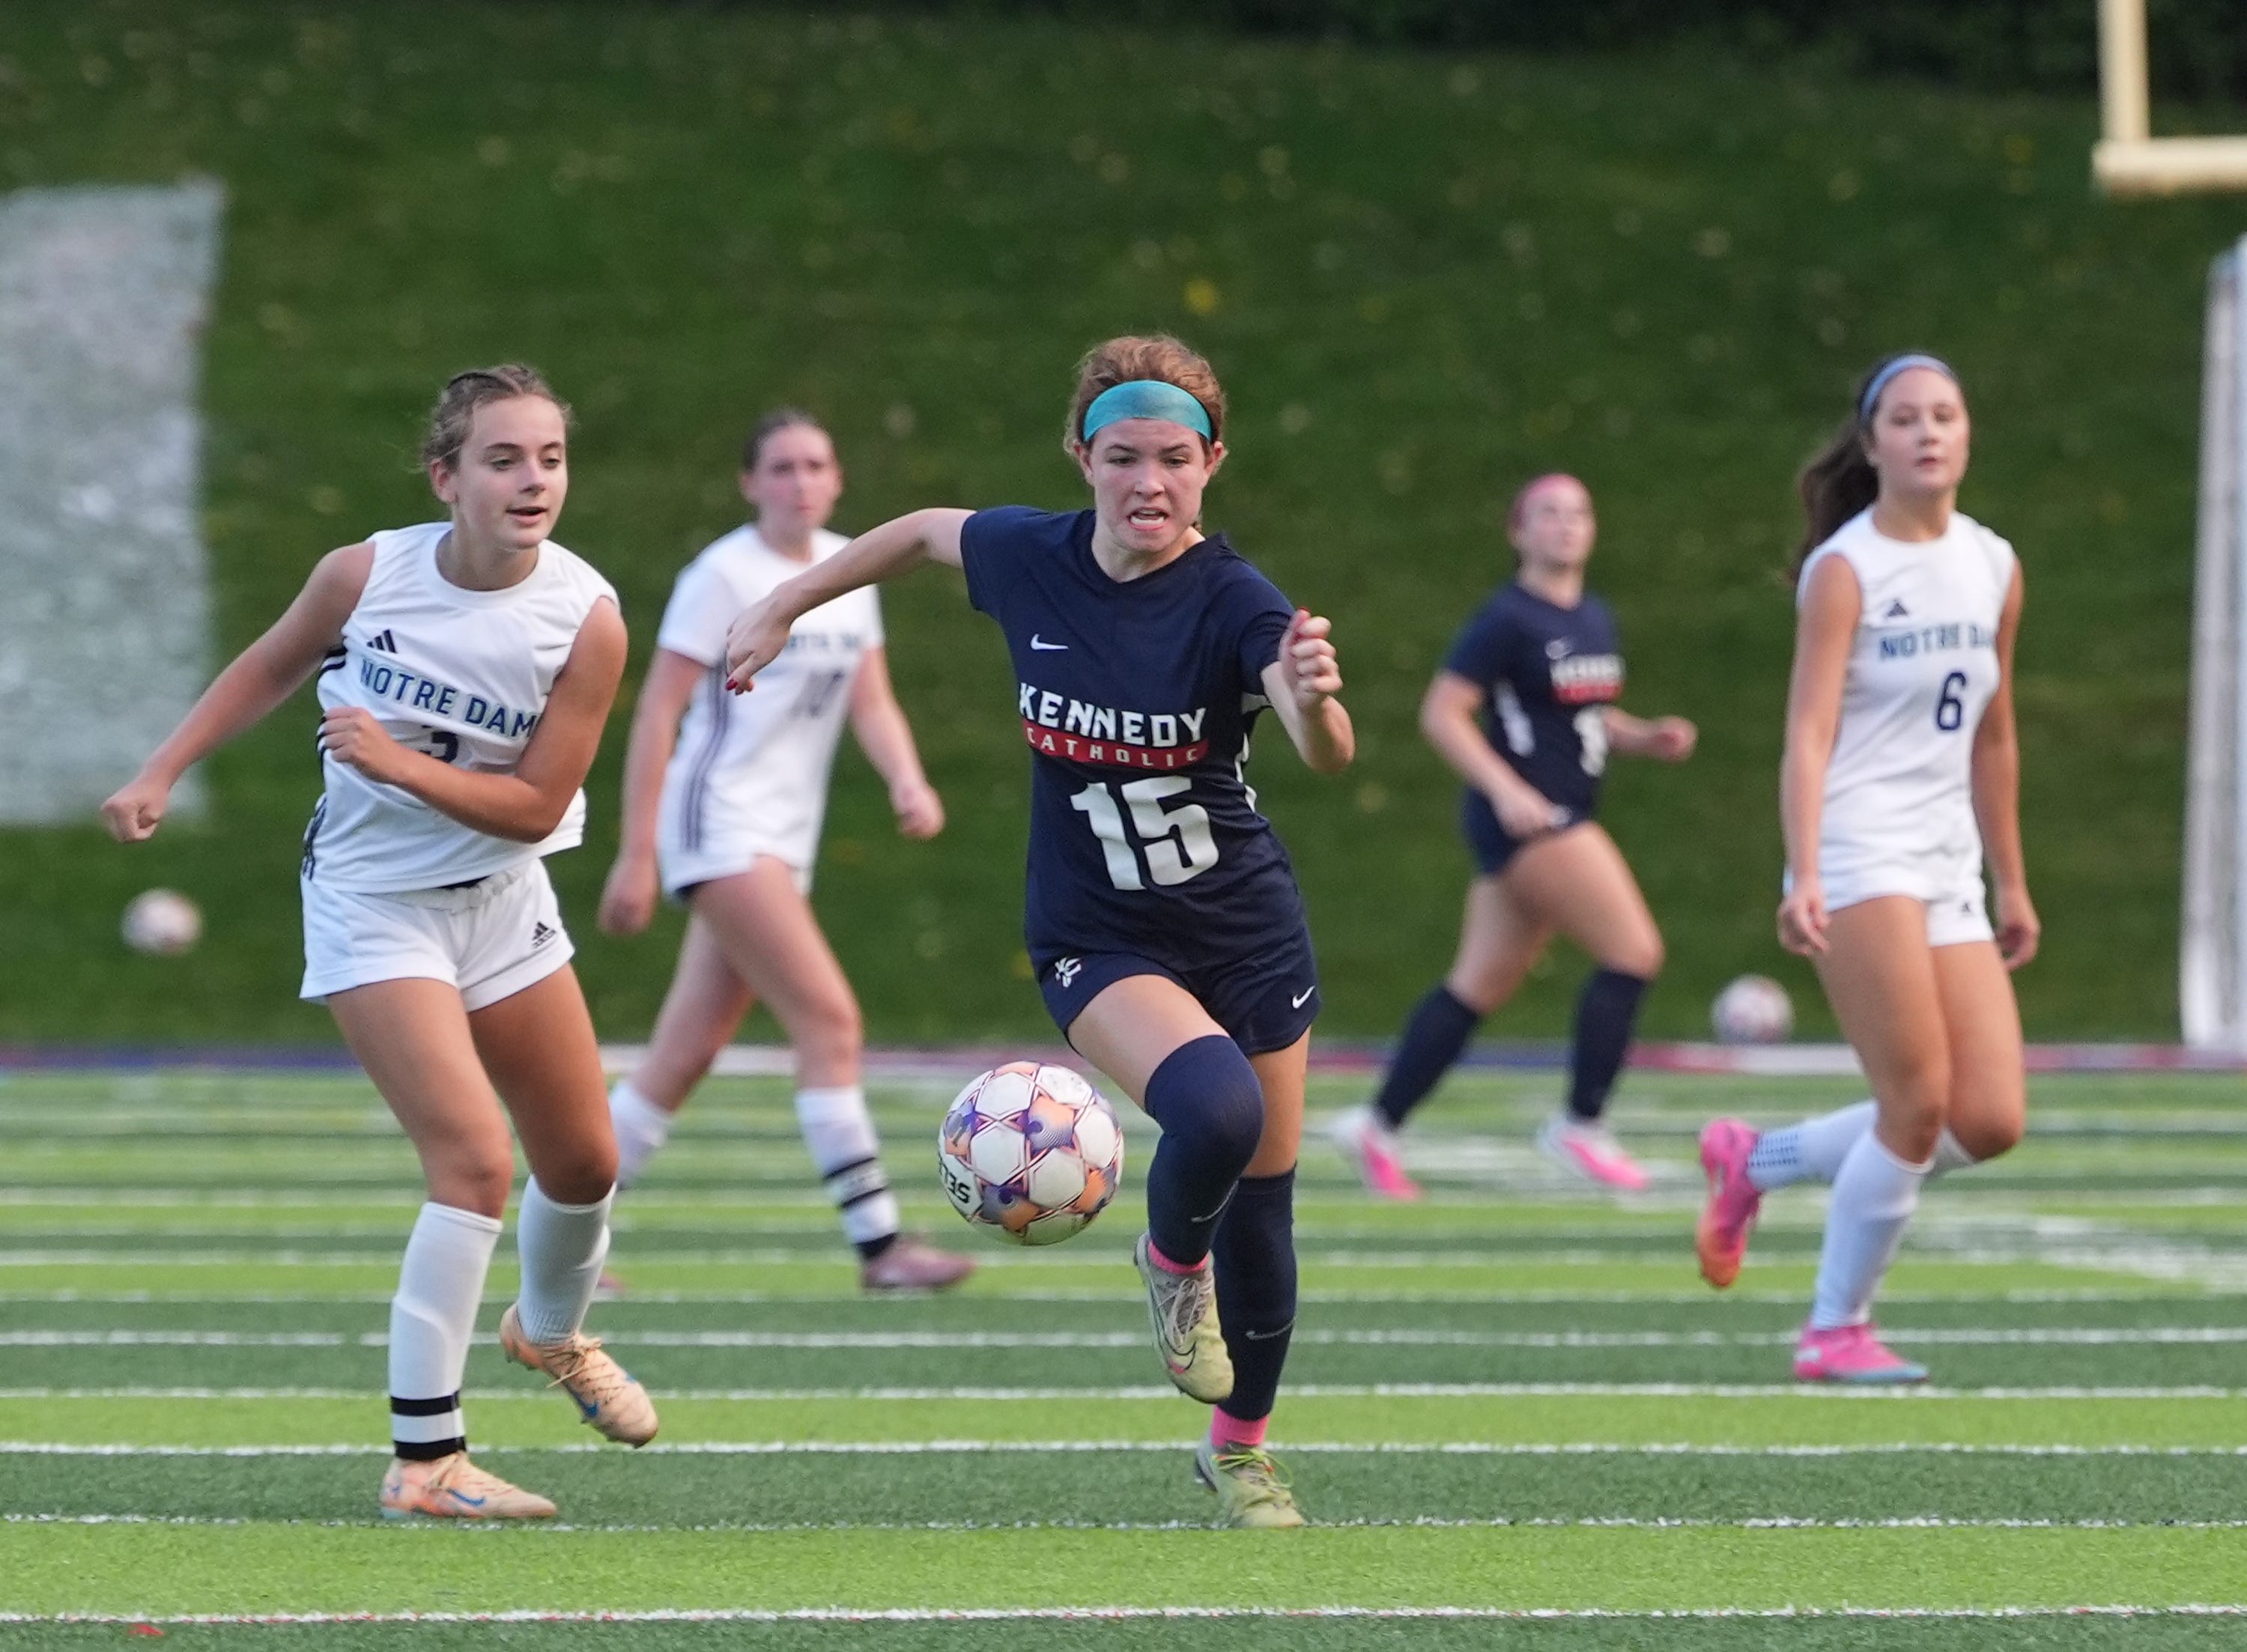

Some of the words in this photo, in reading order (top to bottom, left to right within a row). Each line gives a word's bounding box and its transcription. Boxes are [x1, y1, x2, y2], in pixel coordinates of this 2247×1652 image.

[360, 658, 456, 714] NOTRE
[465, 696, 537, 738] DAM
[1019, 682, 1207, 747] KENNEDY
[1936, 672, 1967, 731] 6
[1026, 726, 1198, 767] CATHOLIC
[1070, 775, 1219, 890] 15
